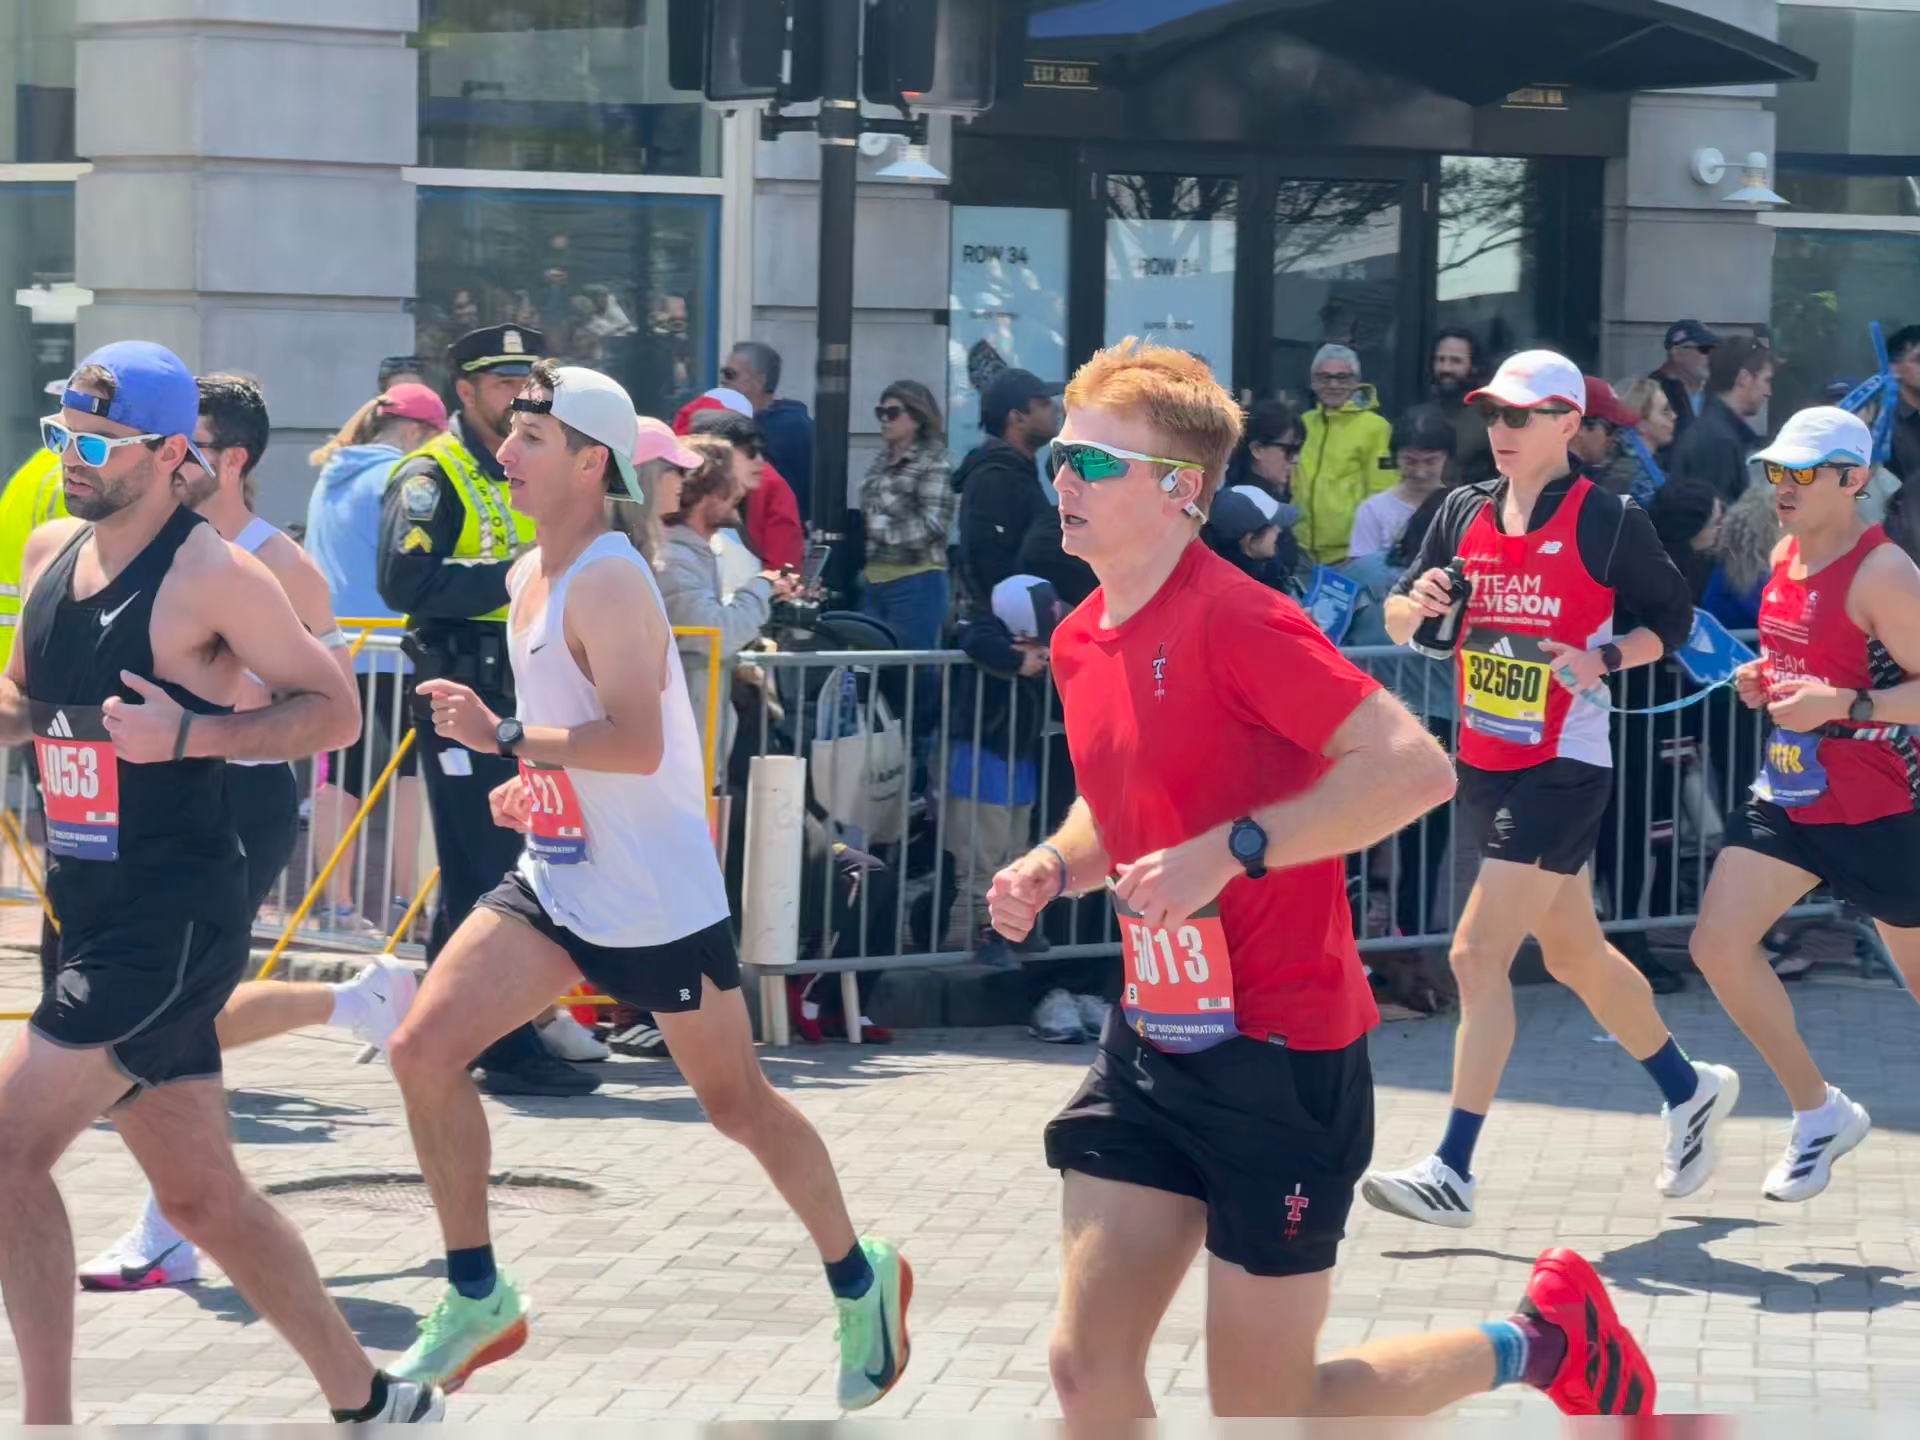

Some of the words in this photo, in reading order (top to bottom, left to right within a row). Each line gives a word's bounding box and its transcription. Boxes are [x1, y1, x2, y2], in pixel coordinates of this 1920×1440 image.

[963, 244, 1004, 264] ROW
[1007, 246, 1029, 265] 34
[1480, 573, 1542, 593] TEAM
[1482, 593, 1562, 617] VISION
[1470, 654, 1542, 703] 32560
[1128, 922, 1210, 985] 5013
[1158, 1023, 1184, 1034] BOSTON
[1184, 1023, 1225, 1034] MARATHON
